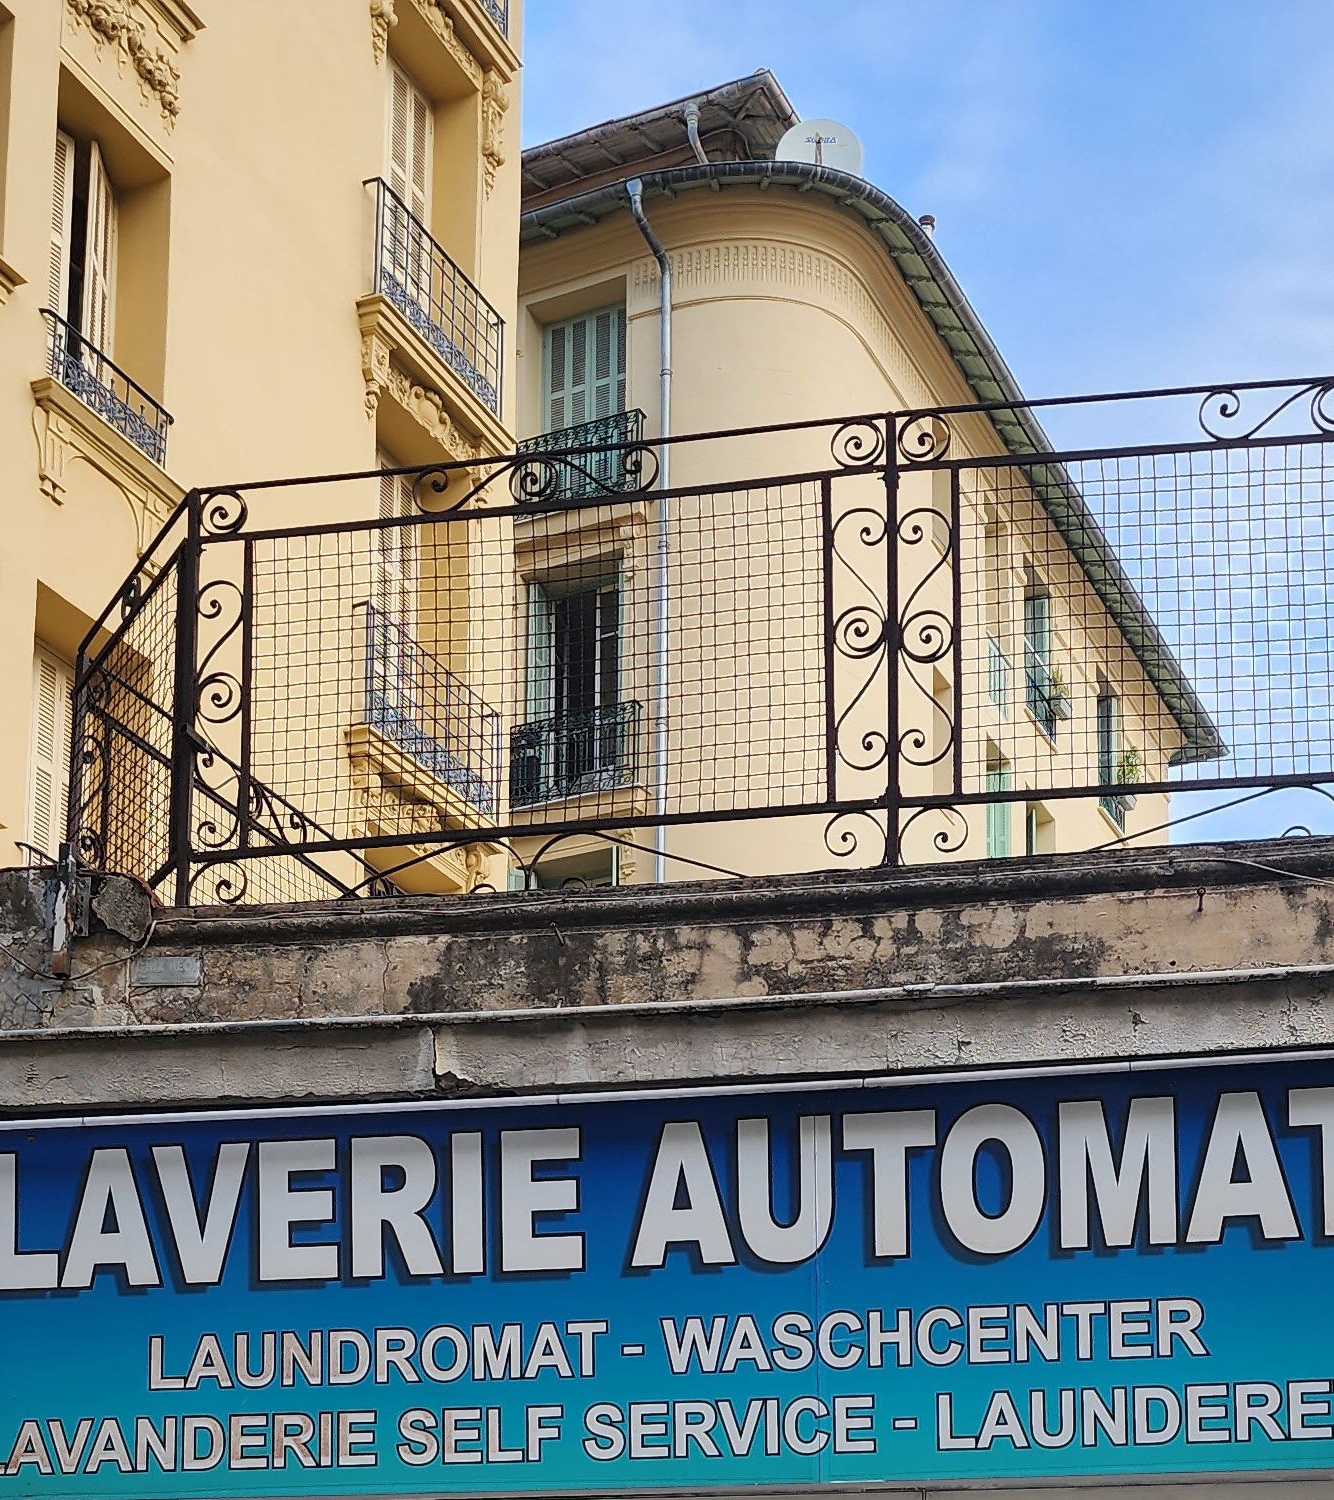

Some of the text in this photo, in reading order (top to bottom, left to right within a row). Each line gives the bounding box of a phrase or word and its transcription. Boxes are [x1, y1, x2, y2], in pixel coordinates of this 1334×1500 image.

[148, 1297, 1208, 1392] LAUNDROMAT - WASCHCENTER
[396, 1404, 563, 1467] SELF
[581, 1394, 876, 1461] SERVICE
[893, 1417, 918, 1432] -
